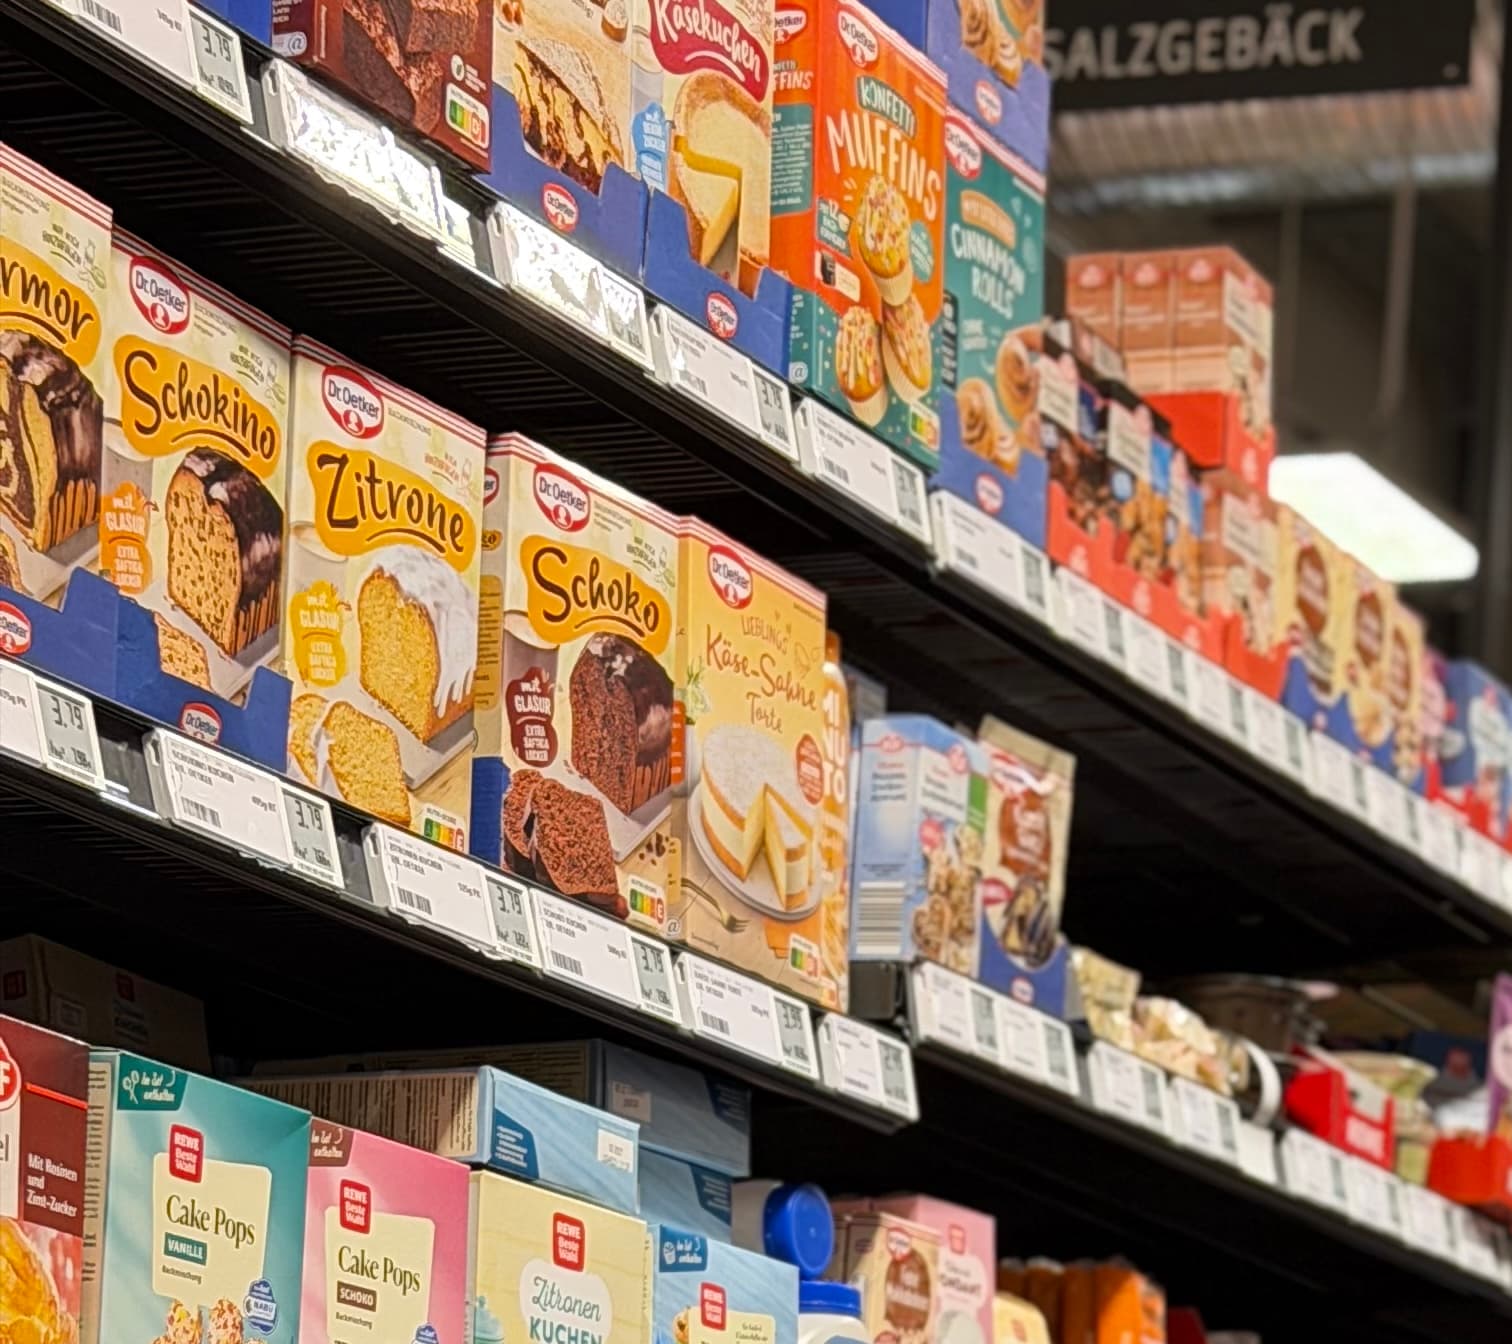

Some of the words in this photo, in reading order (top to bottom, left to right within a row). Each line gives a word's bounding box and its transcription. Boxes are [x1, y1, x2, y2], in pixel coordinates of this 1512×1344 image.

[1043, 3, 1365, 80] SALZGEBÄCK
[826, 108, 942, 221] MUFFINS
[0, 255, 95, 340] rmor
[124, 350, 276, 460] Schokino
[317, 452, 465, 553] Zitrone
[532, 547, 660, 633] Schoko
[746, 691, 784, 734] Torte
[27, 1152, 44, 1172] Mit
[174, 1133, 200, 1152] REWE
[166, 1195, 210, 1232] Cake
[214, 1206, 256, 1249] Pops
[556, 1220, 581, 1240] REWE
[168, 1238, 203, 1260] VANILLE
[338, 1245, 379, 1281] Cake
[383, 1256, 421, 1297] Pops
[339, 1286, 374, 1306] SCHOKO
[531, 1275, 602, 1323] Zitronen
